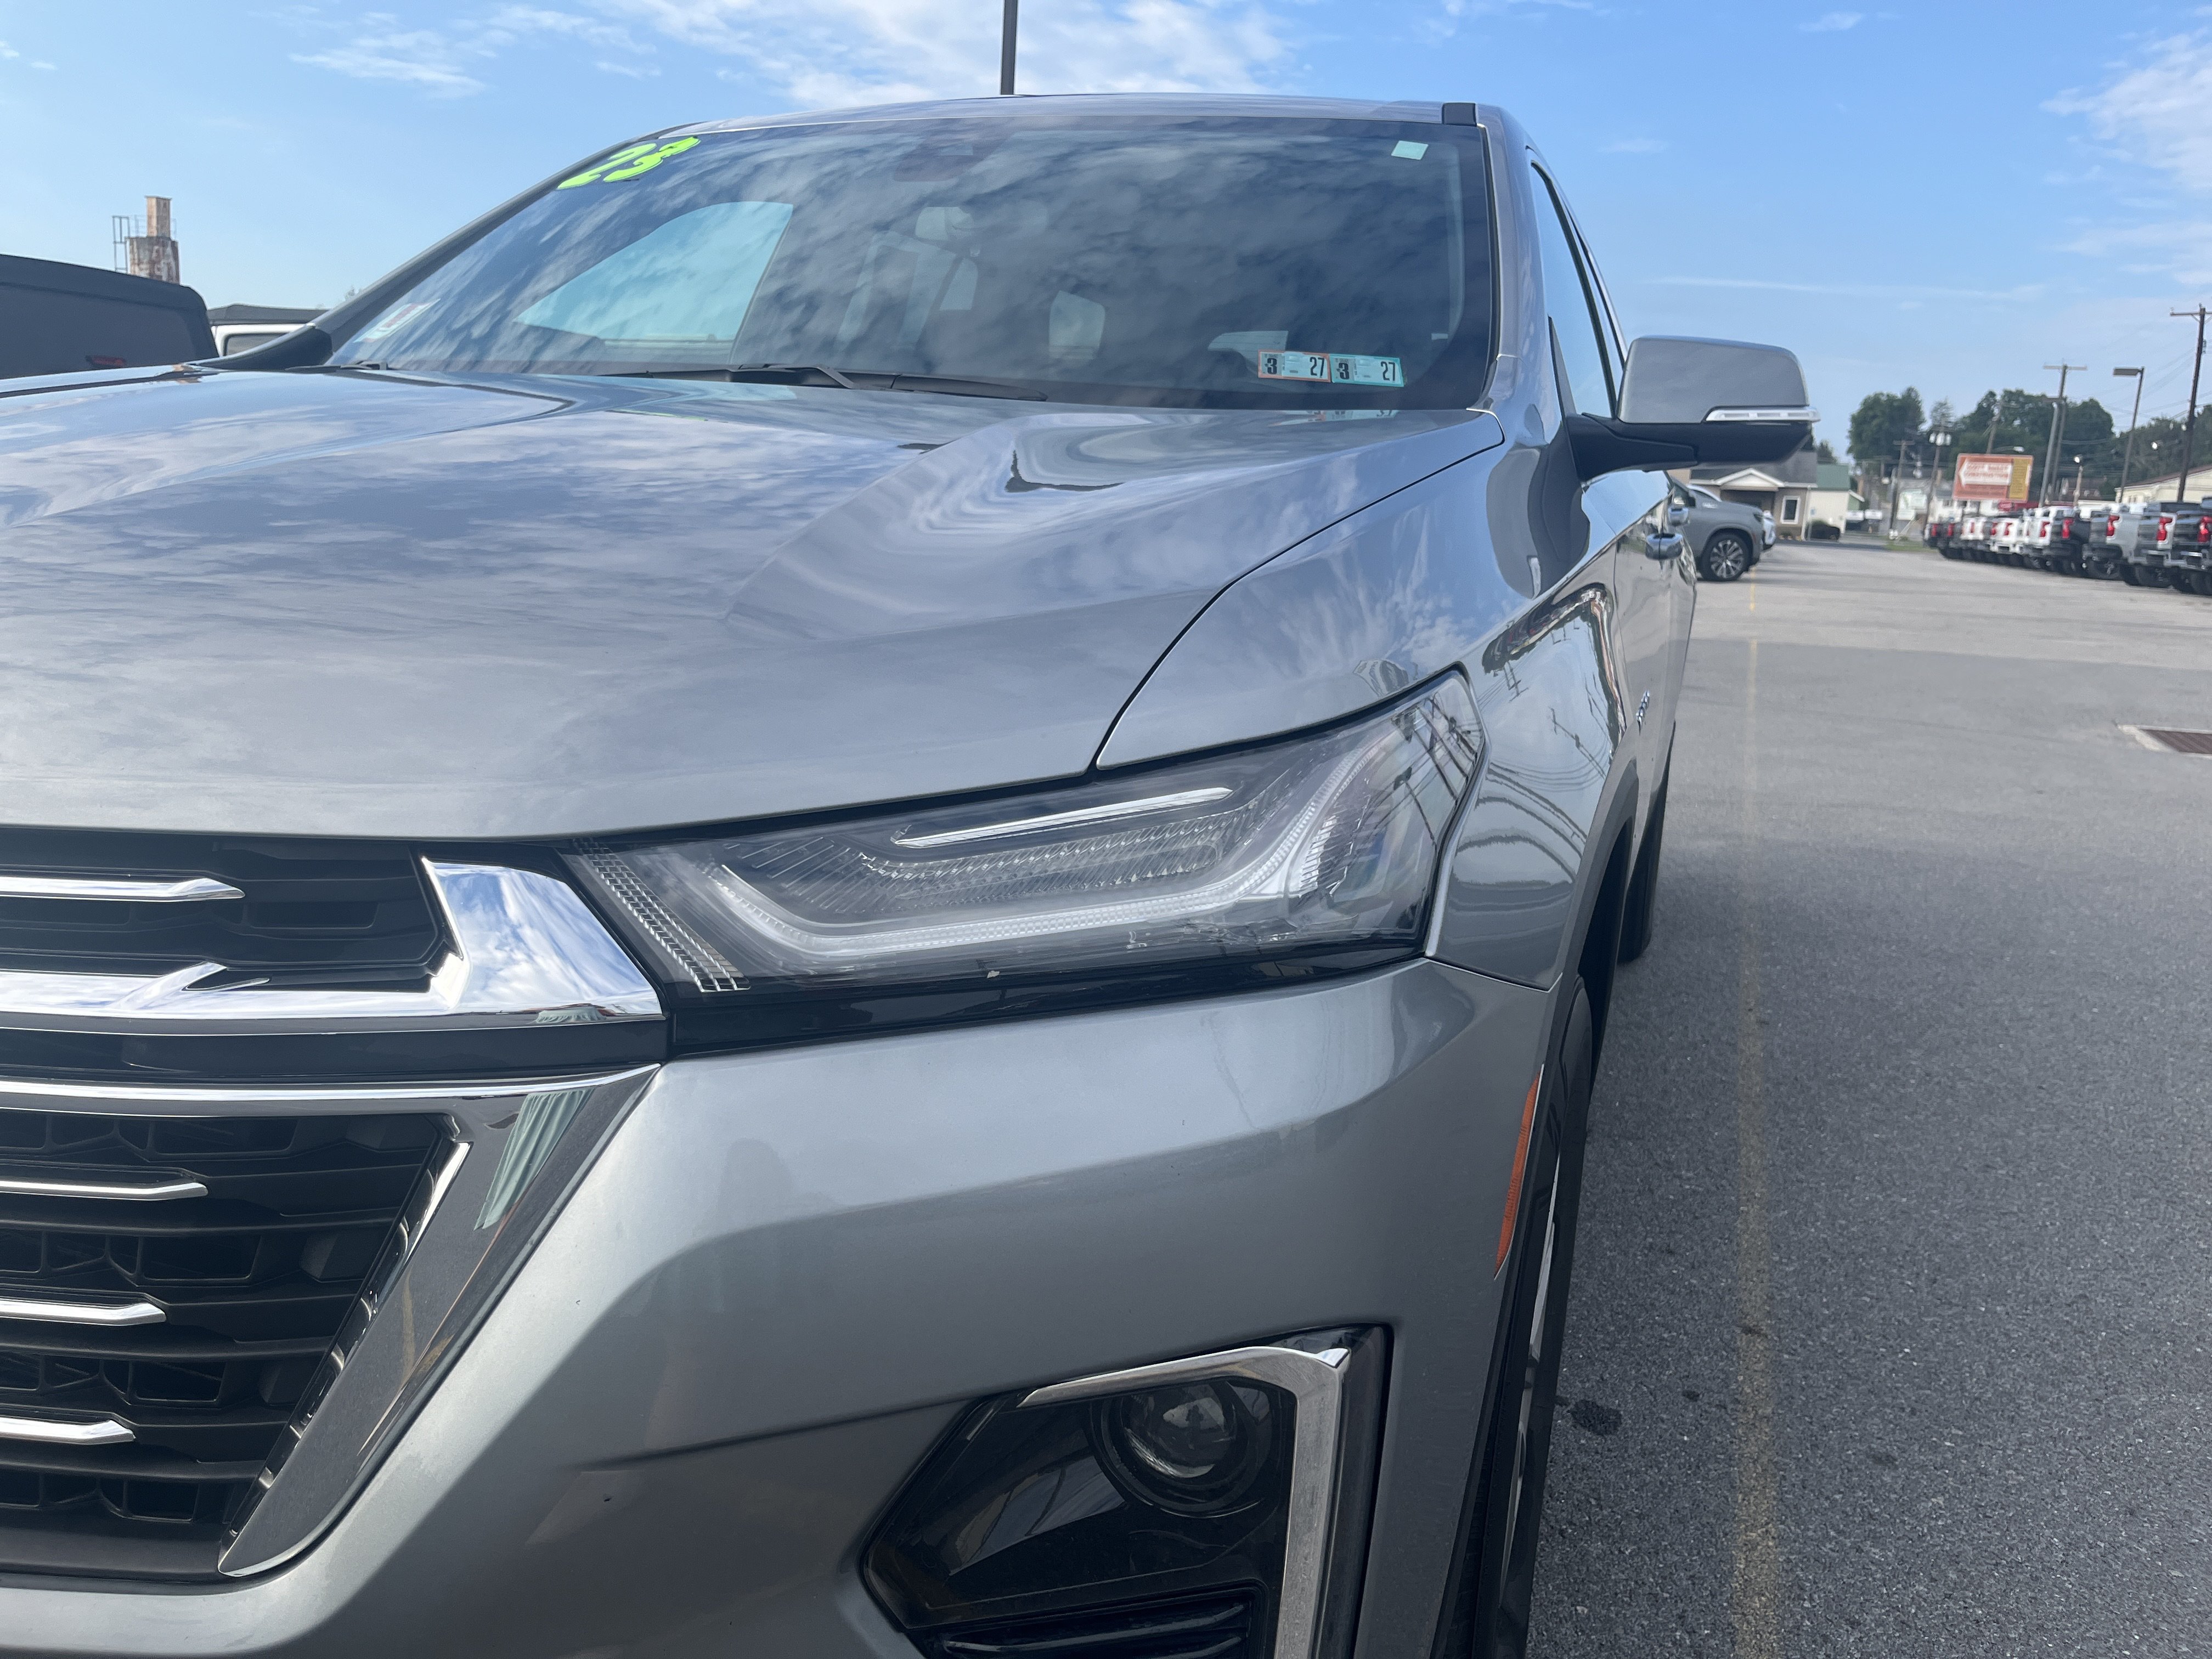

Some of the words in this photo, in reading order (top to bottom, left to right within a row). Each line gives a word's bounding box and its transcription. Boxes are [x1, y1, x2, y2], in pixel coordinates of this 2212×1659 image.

[557, 136, 701, 190] 23
[1267, 358, 1277, 375] 3
[1310, 357, 1325, 378] 27
[1339, 363, 1350, 380] 3
[1380, 361, 1396, 381] 27
